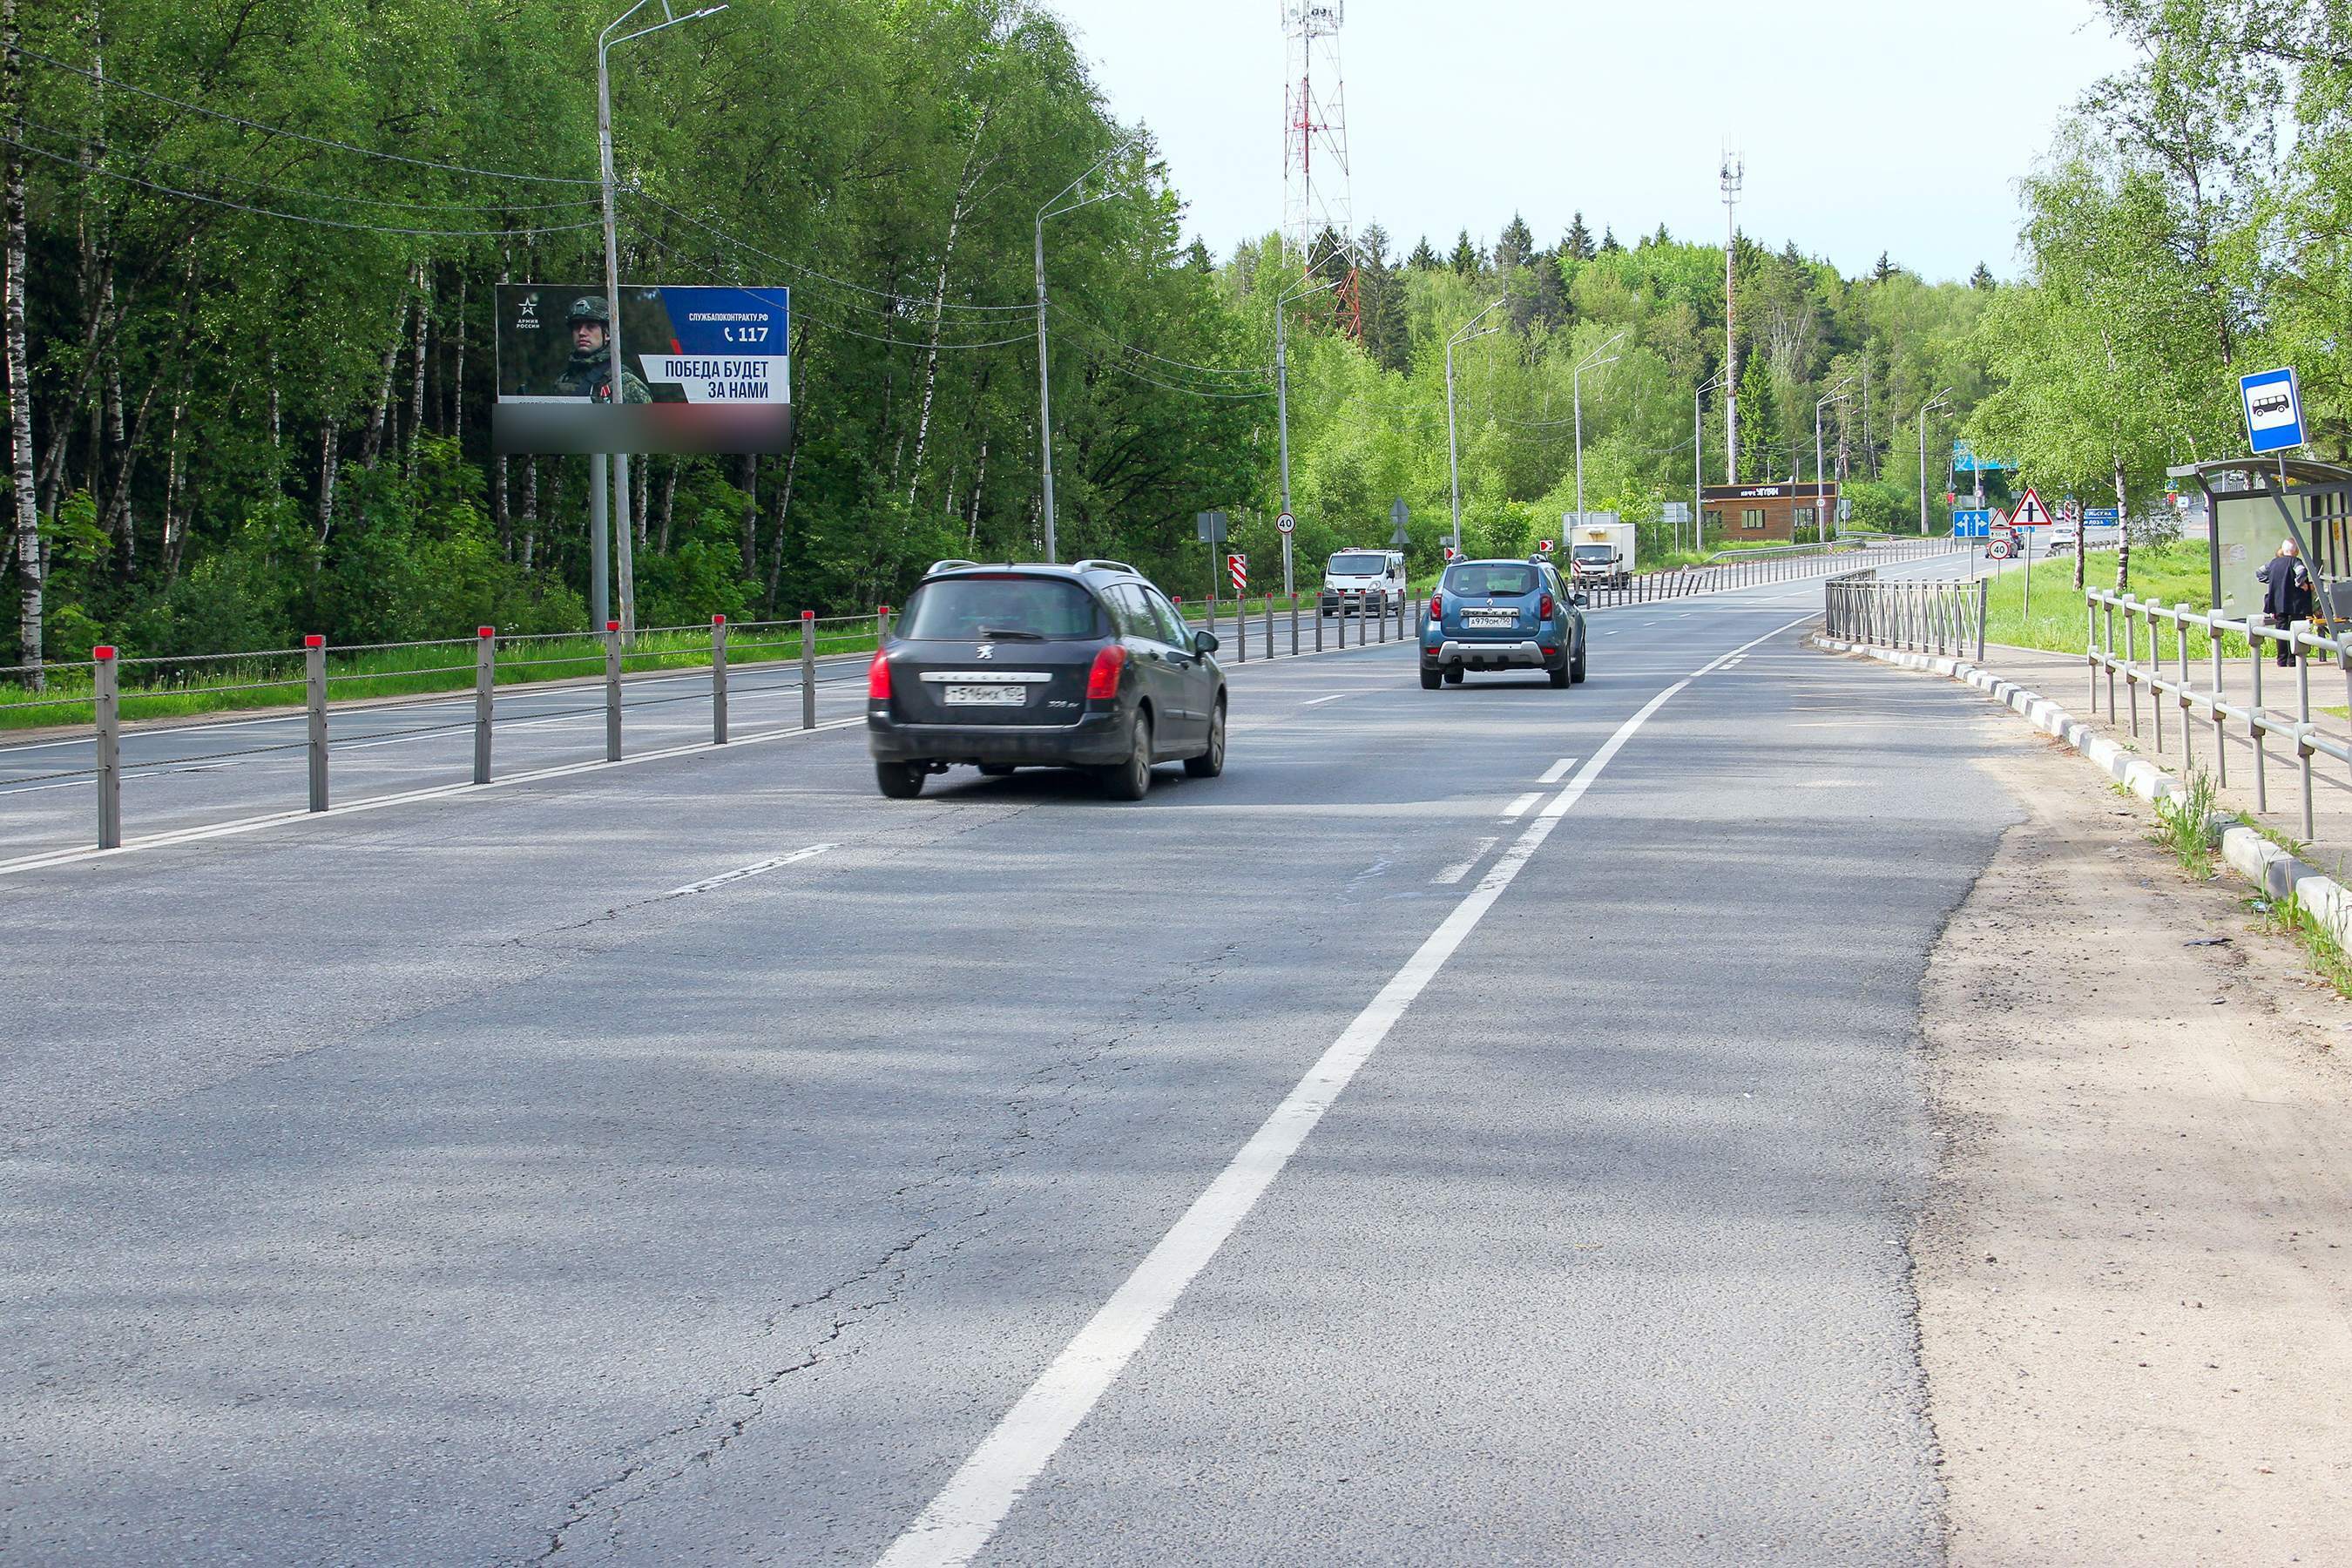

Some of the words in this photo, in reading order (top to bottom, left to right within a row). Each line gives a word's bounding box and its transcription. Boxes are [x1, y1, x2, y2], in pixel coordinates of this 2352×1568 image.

[689, 313, 768, 321] СЛУЖБАПОКОНТРАКТУ.РФ
[739, 327, 769, 342] 117
[665, 361, 720, 380] ПОБЕДА
[724, 361, 769, 380] БУДЕТ
[708, 382, 726, 398] ЗА
[729, 382, 769, 398] НАМИ
